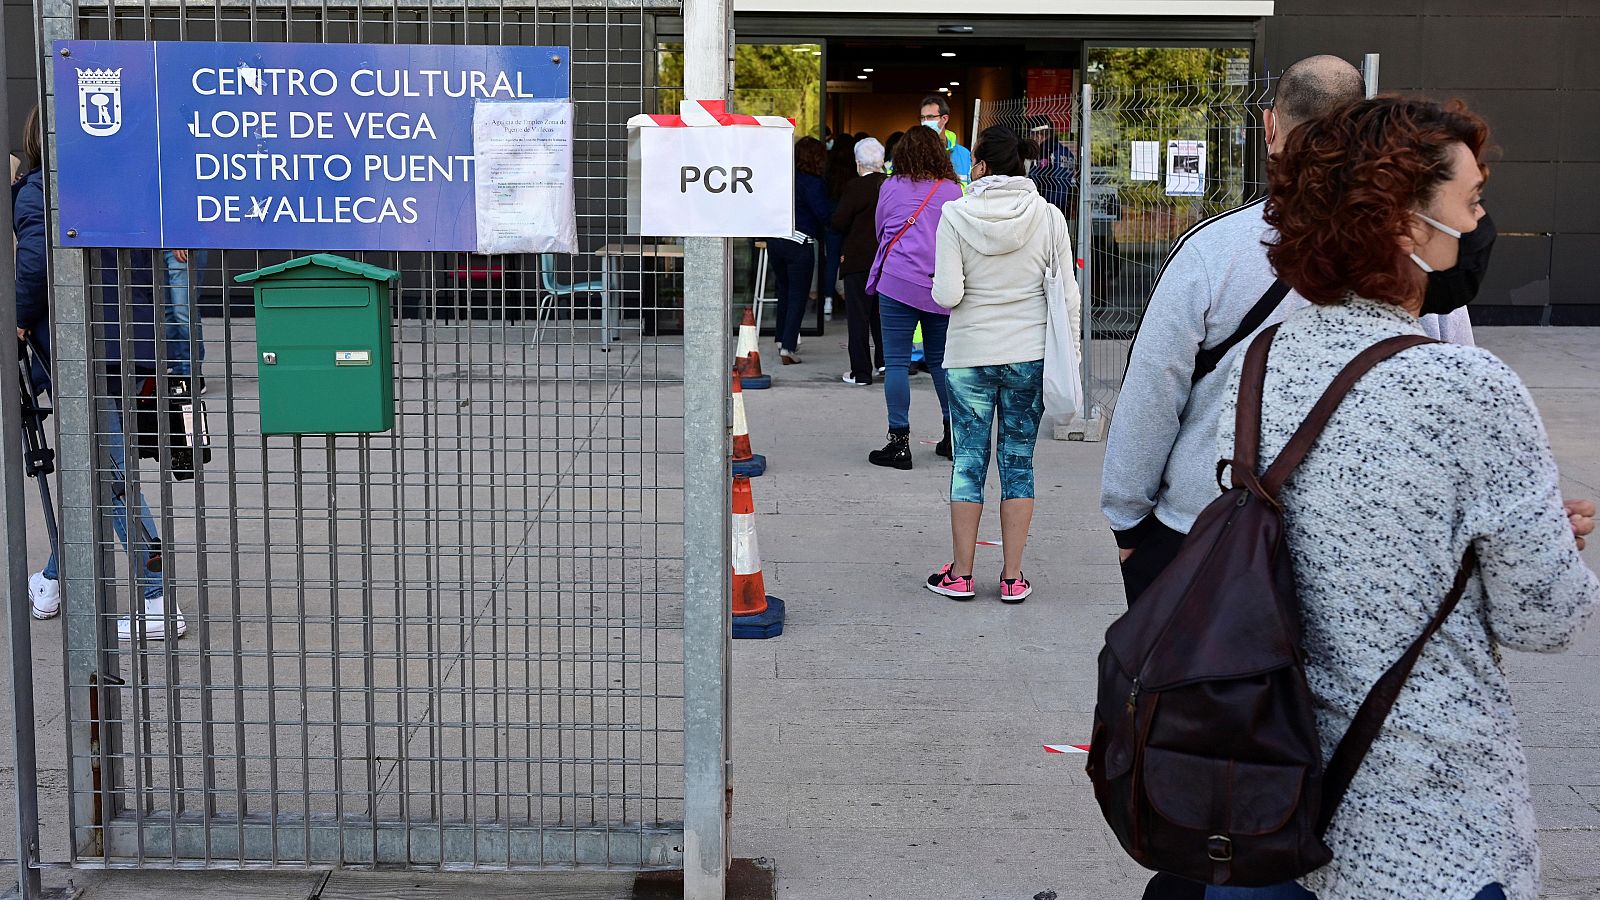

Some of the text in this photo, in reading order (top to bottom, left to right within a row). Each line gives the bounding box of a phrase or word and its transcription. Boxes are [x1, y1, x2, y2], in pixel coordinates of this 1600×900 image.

[193, 68, 534, 98] CENTRO CULTURAL
[194, 111, 437, 140] LOPE DE VEGA
[196, 153, 476, 183] DISTRITO PUENT
[680, 165, 754, 194] PCR
[196, 196, 418, 224] DE VALLECAS
